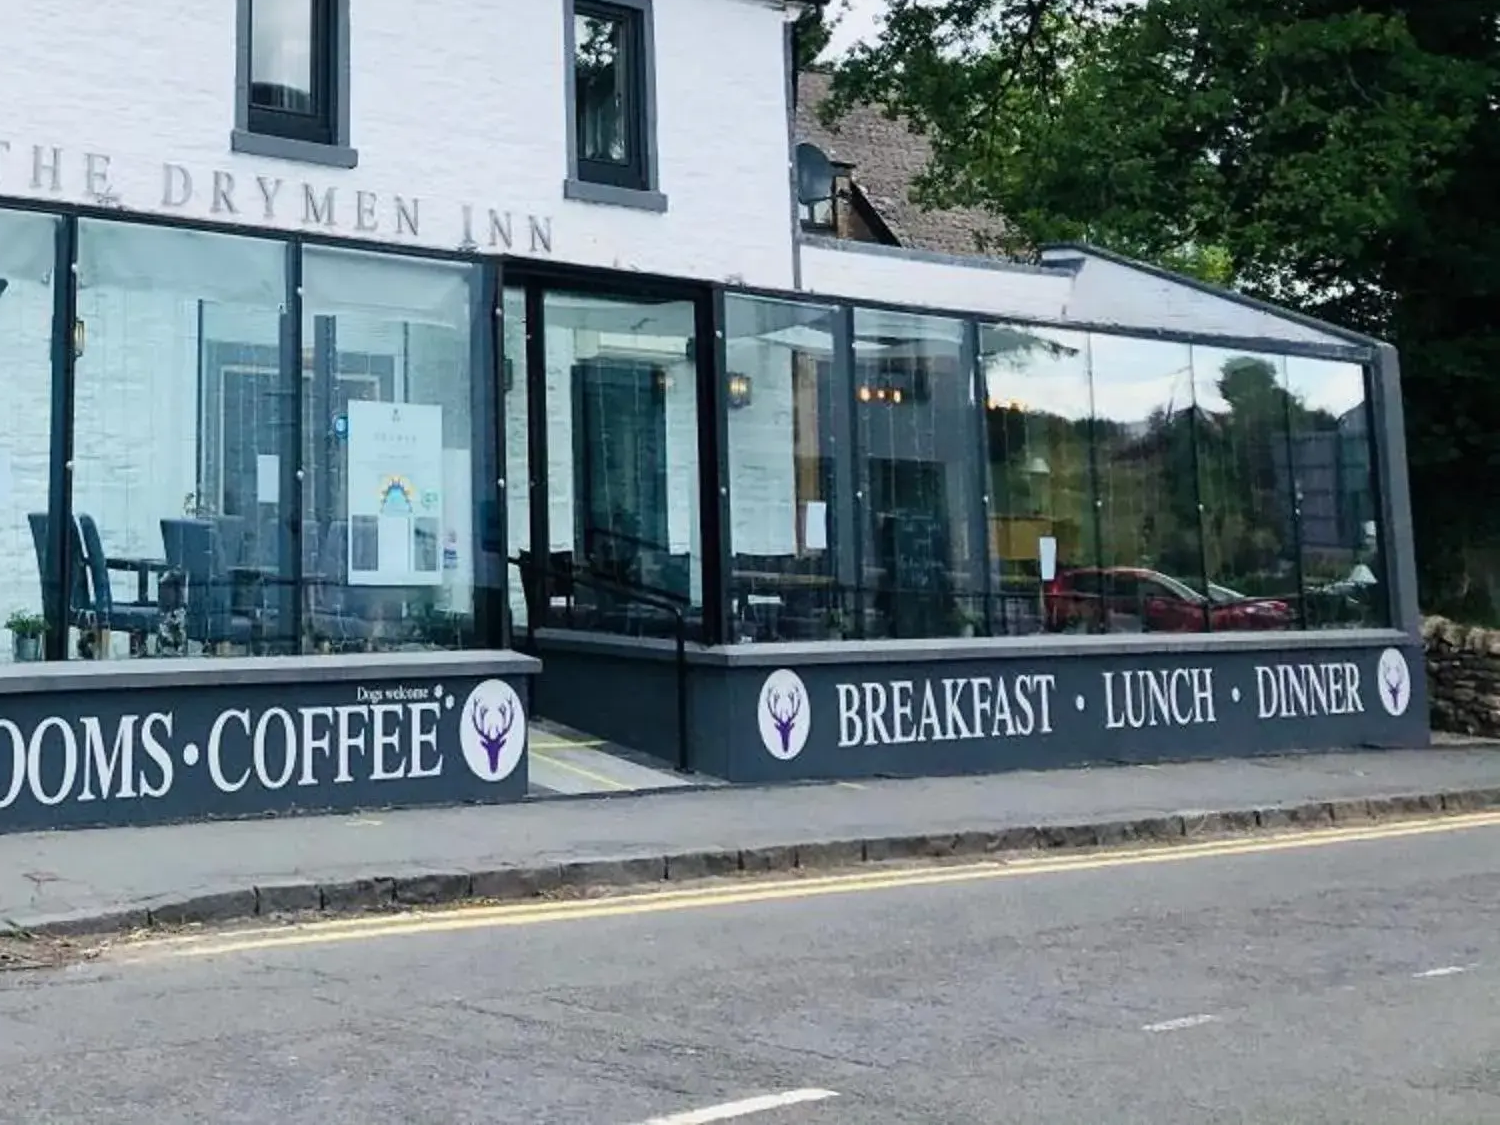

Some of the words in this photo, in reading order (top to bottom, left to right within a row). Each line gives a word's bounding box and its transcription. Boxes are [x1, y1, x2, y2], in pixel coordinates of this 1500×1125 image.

[162, 161, 422, 237] DRYMEN
[460, 204, 554, 254] INN
[357, 686, 383, 704] Dogs
[385, 685, 429, 700] welcome
[836, 674, 1056, 748] BREAKFAST
[1104, 667, 1216, 729] LUNCH
[1254, 662, 1365, 720] DINNER
[207, 702, 444, 793] COFFEE
